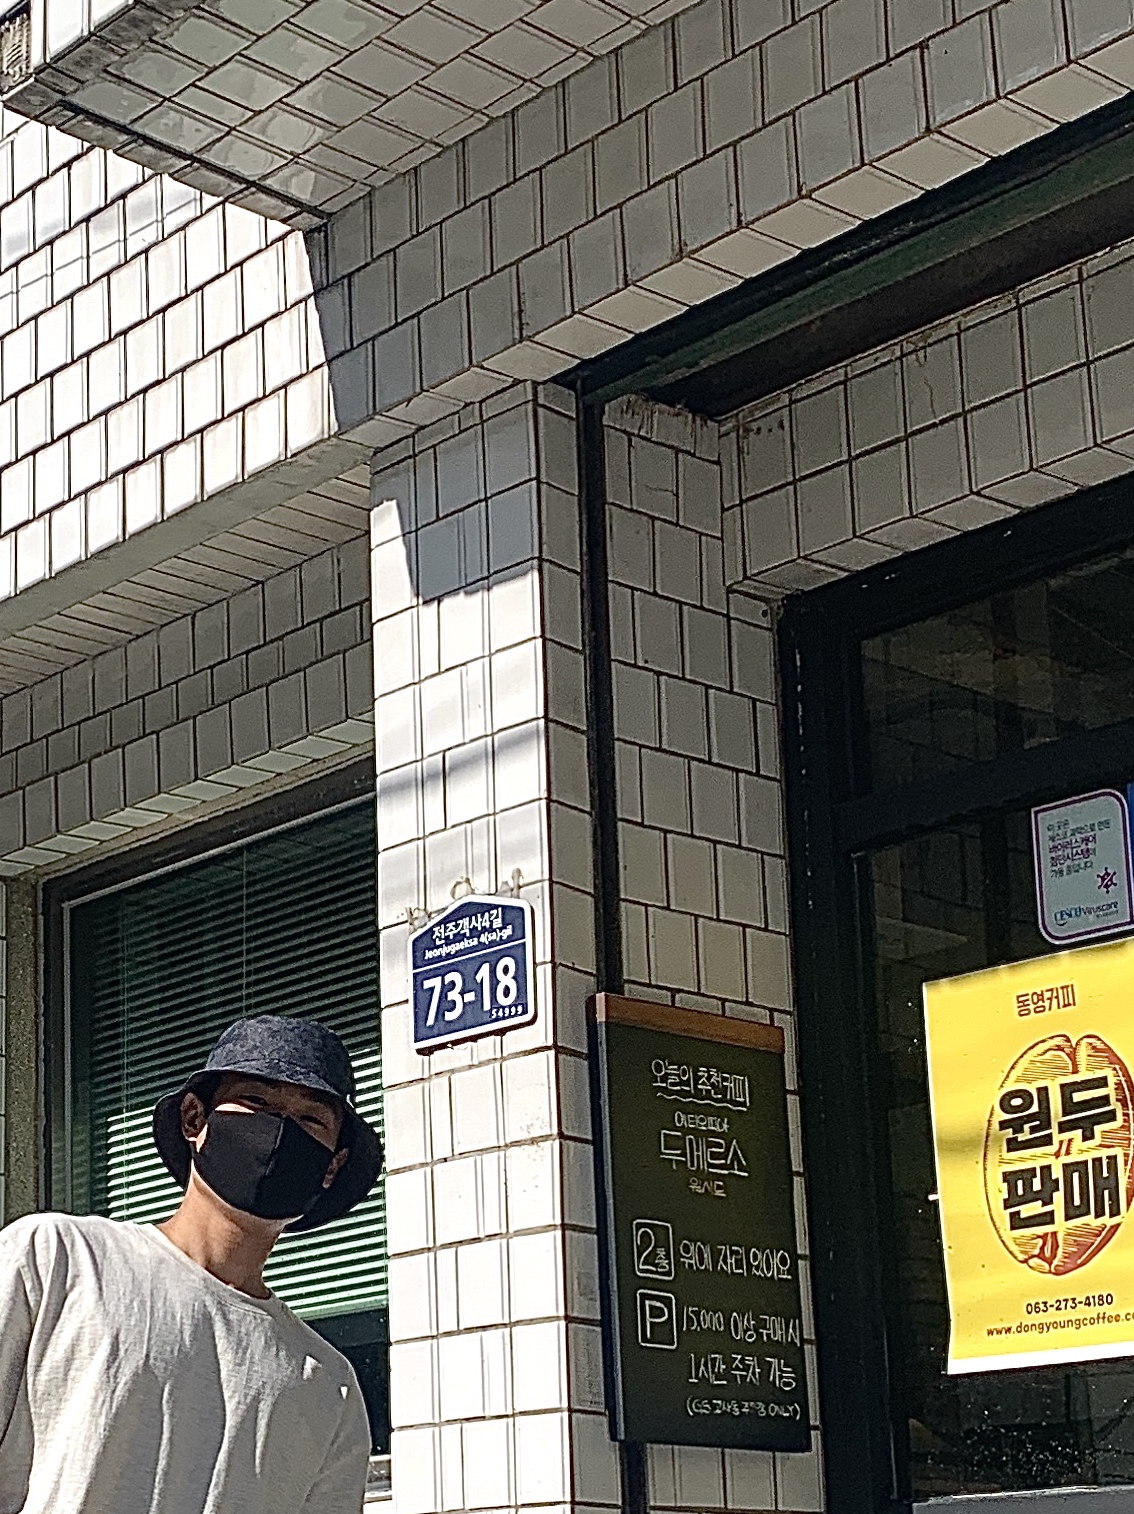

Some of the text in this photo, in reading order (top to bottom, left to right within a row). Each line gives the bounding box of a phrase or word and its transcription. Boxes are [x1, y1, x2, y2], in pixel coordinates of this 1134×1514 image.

[432, 907, 503, 945] 전주객사4길
[424, 937, 479, 960] Jeonjugaeksa
[422, 956, 517, 1027] 73-18
[1016, 984, 1076, 1017] 동영커피
[651, 1059, 695, 1094] 오늘의
[998, 1075, 1118, 1153] 원두
[660, 1130, 749, 1177] 두메르소
[1001, 1153, 1121, 1231] 판매
[637, 1227, 792, 1280] 2층 위에 자리 있어요
[1026, 1293, 1114, 1315] 063-273-4180
[730, 1309, 756, 1343] 이상
[688, 1353, 797, 1390] 1시간 주차 가능
